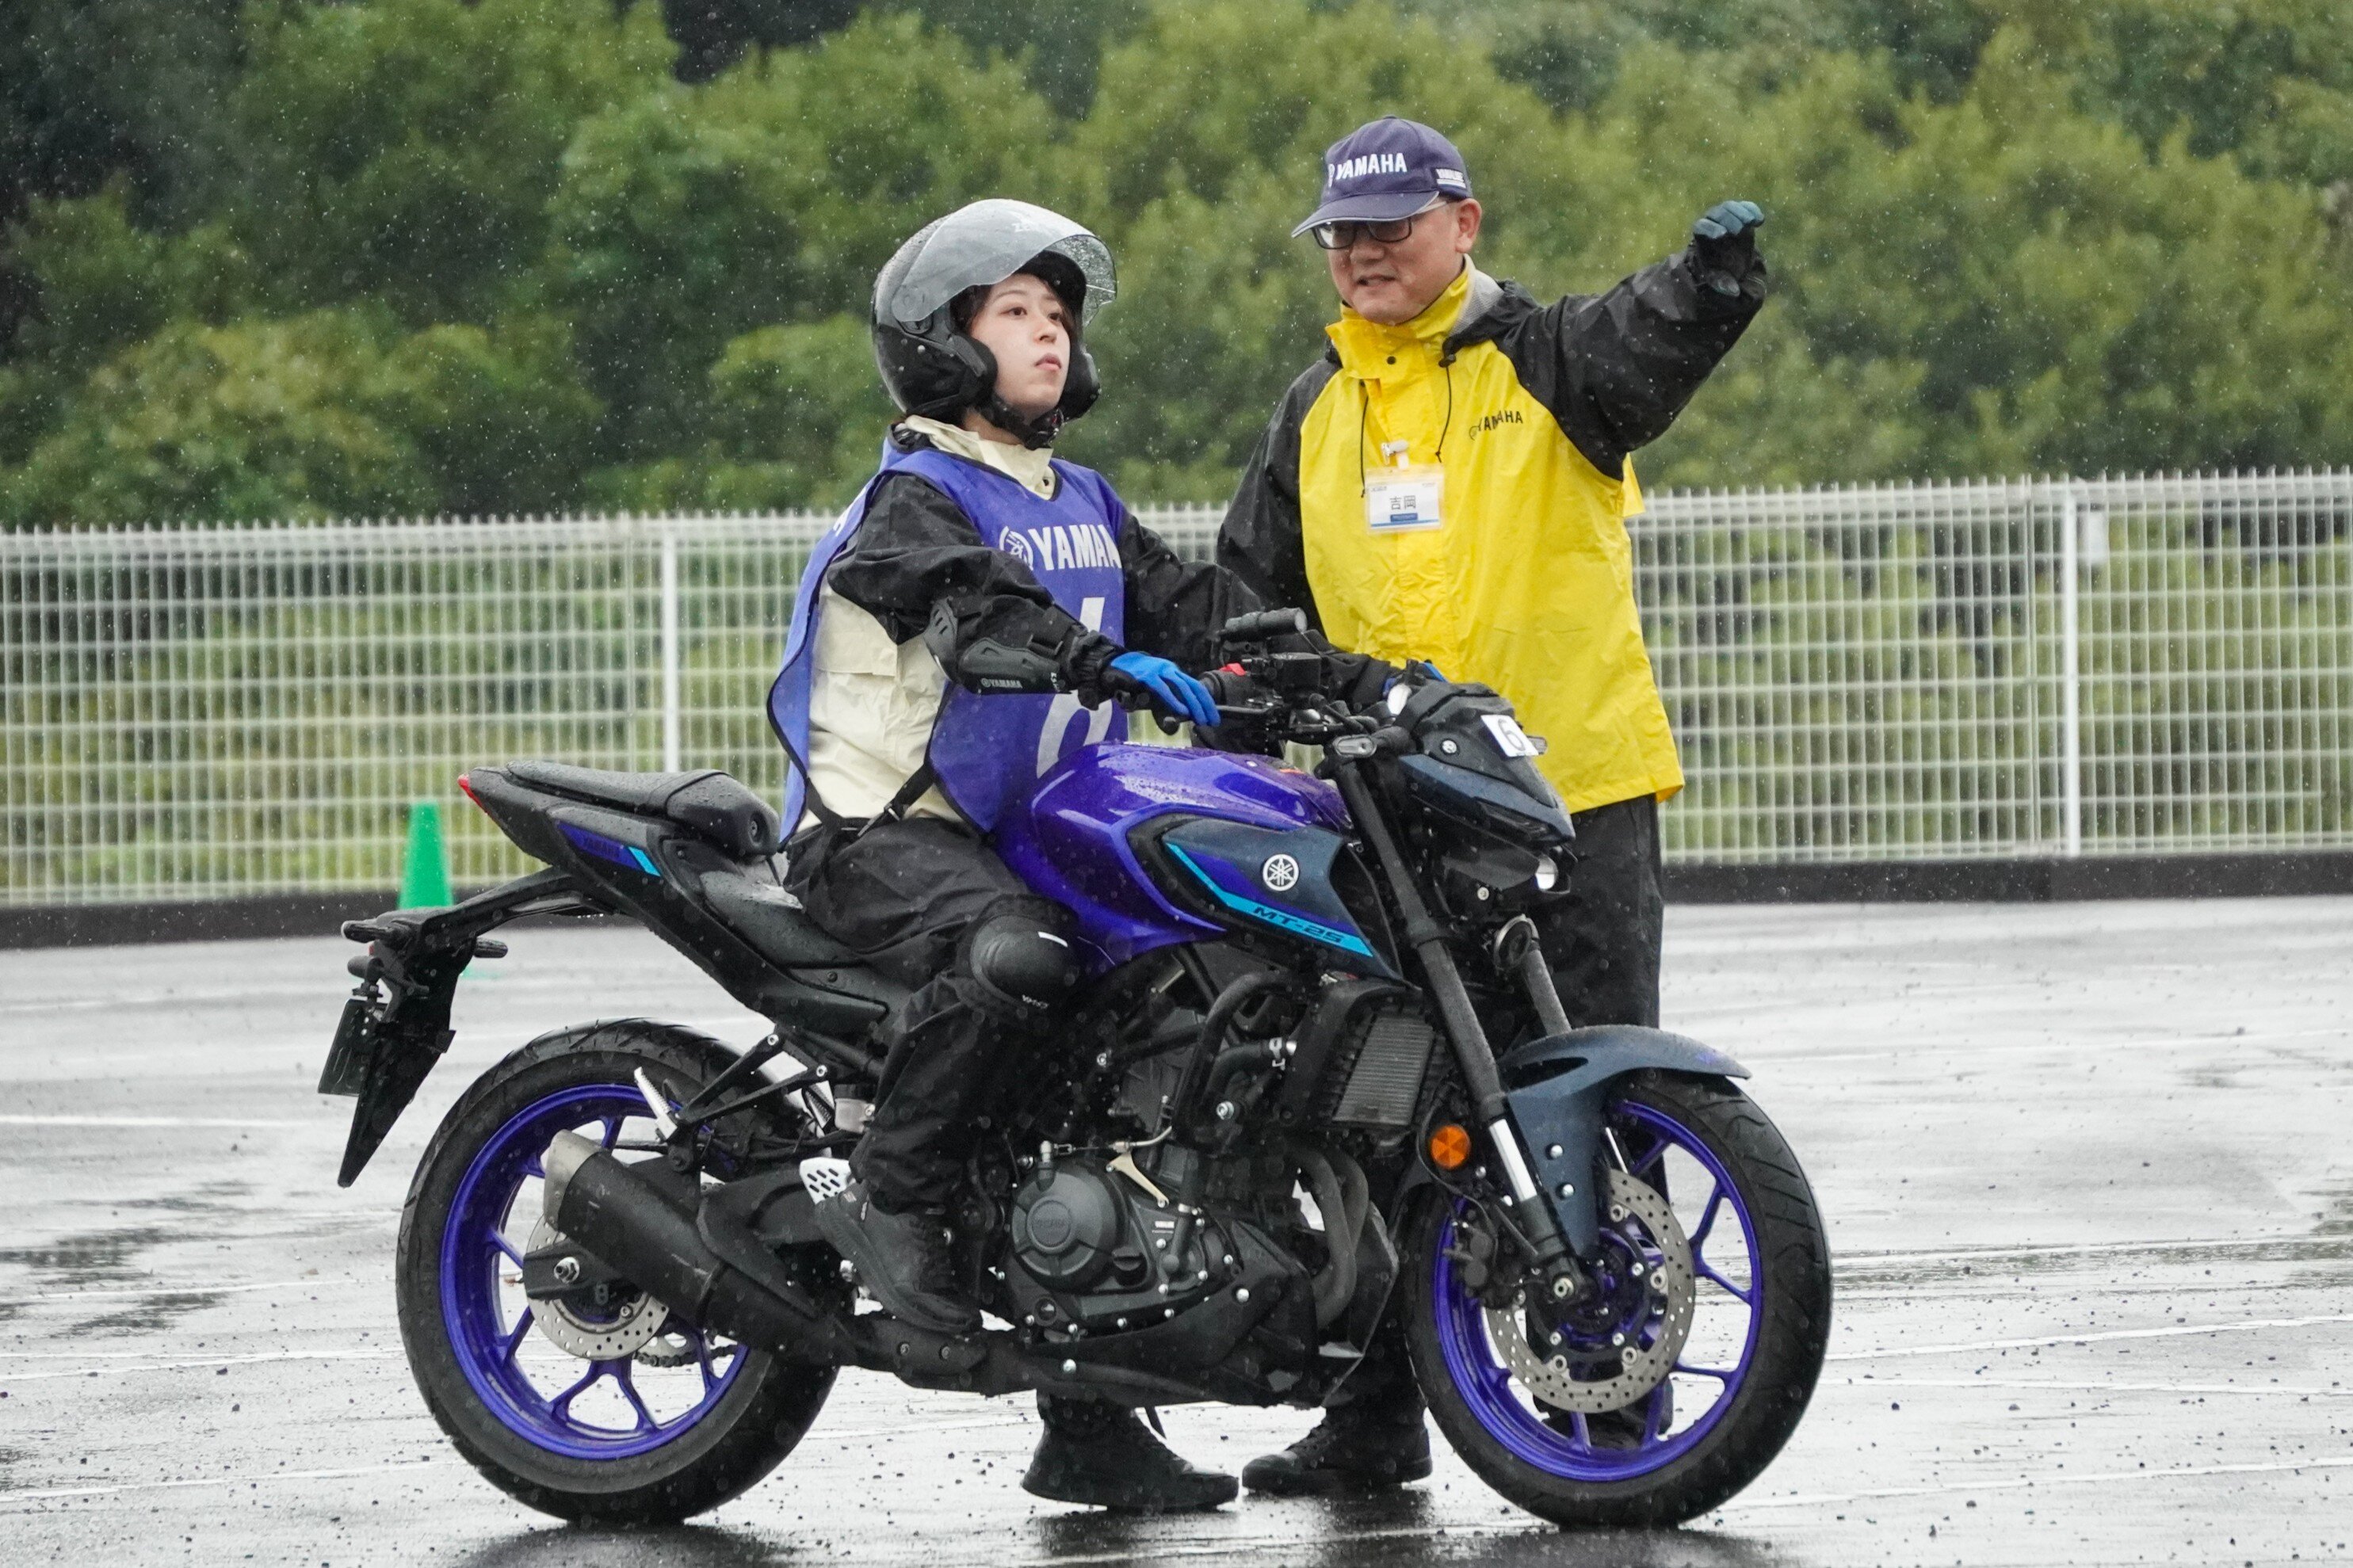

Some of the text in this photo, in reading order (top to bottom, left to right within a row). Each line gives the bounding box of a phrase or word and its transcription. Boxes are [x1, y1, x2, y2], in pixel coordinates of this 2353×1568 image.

[1335, 153, 1408, 180] YAMAHA
[1389, 495, 1416, 510] 吉岡
[1028, 524, 1122, 570] YAMAH
[1497, 717, 1526, 751] 6
[1253, 906, 1345, 944] MT-25
